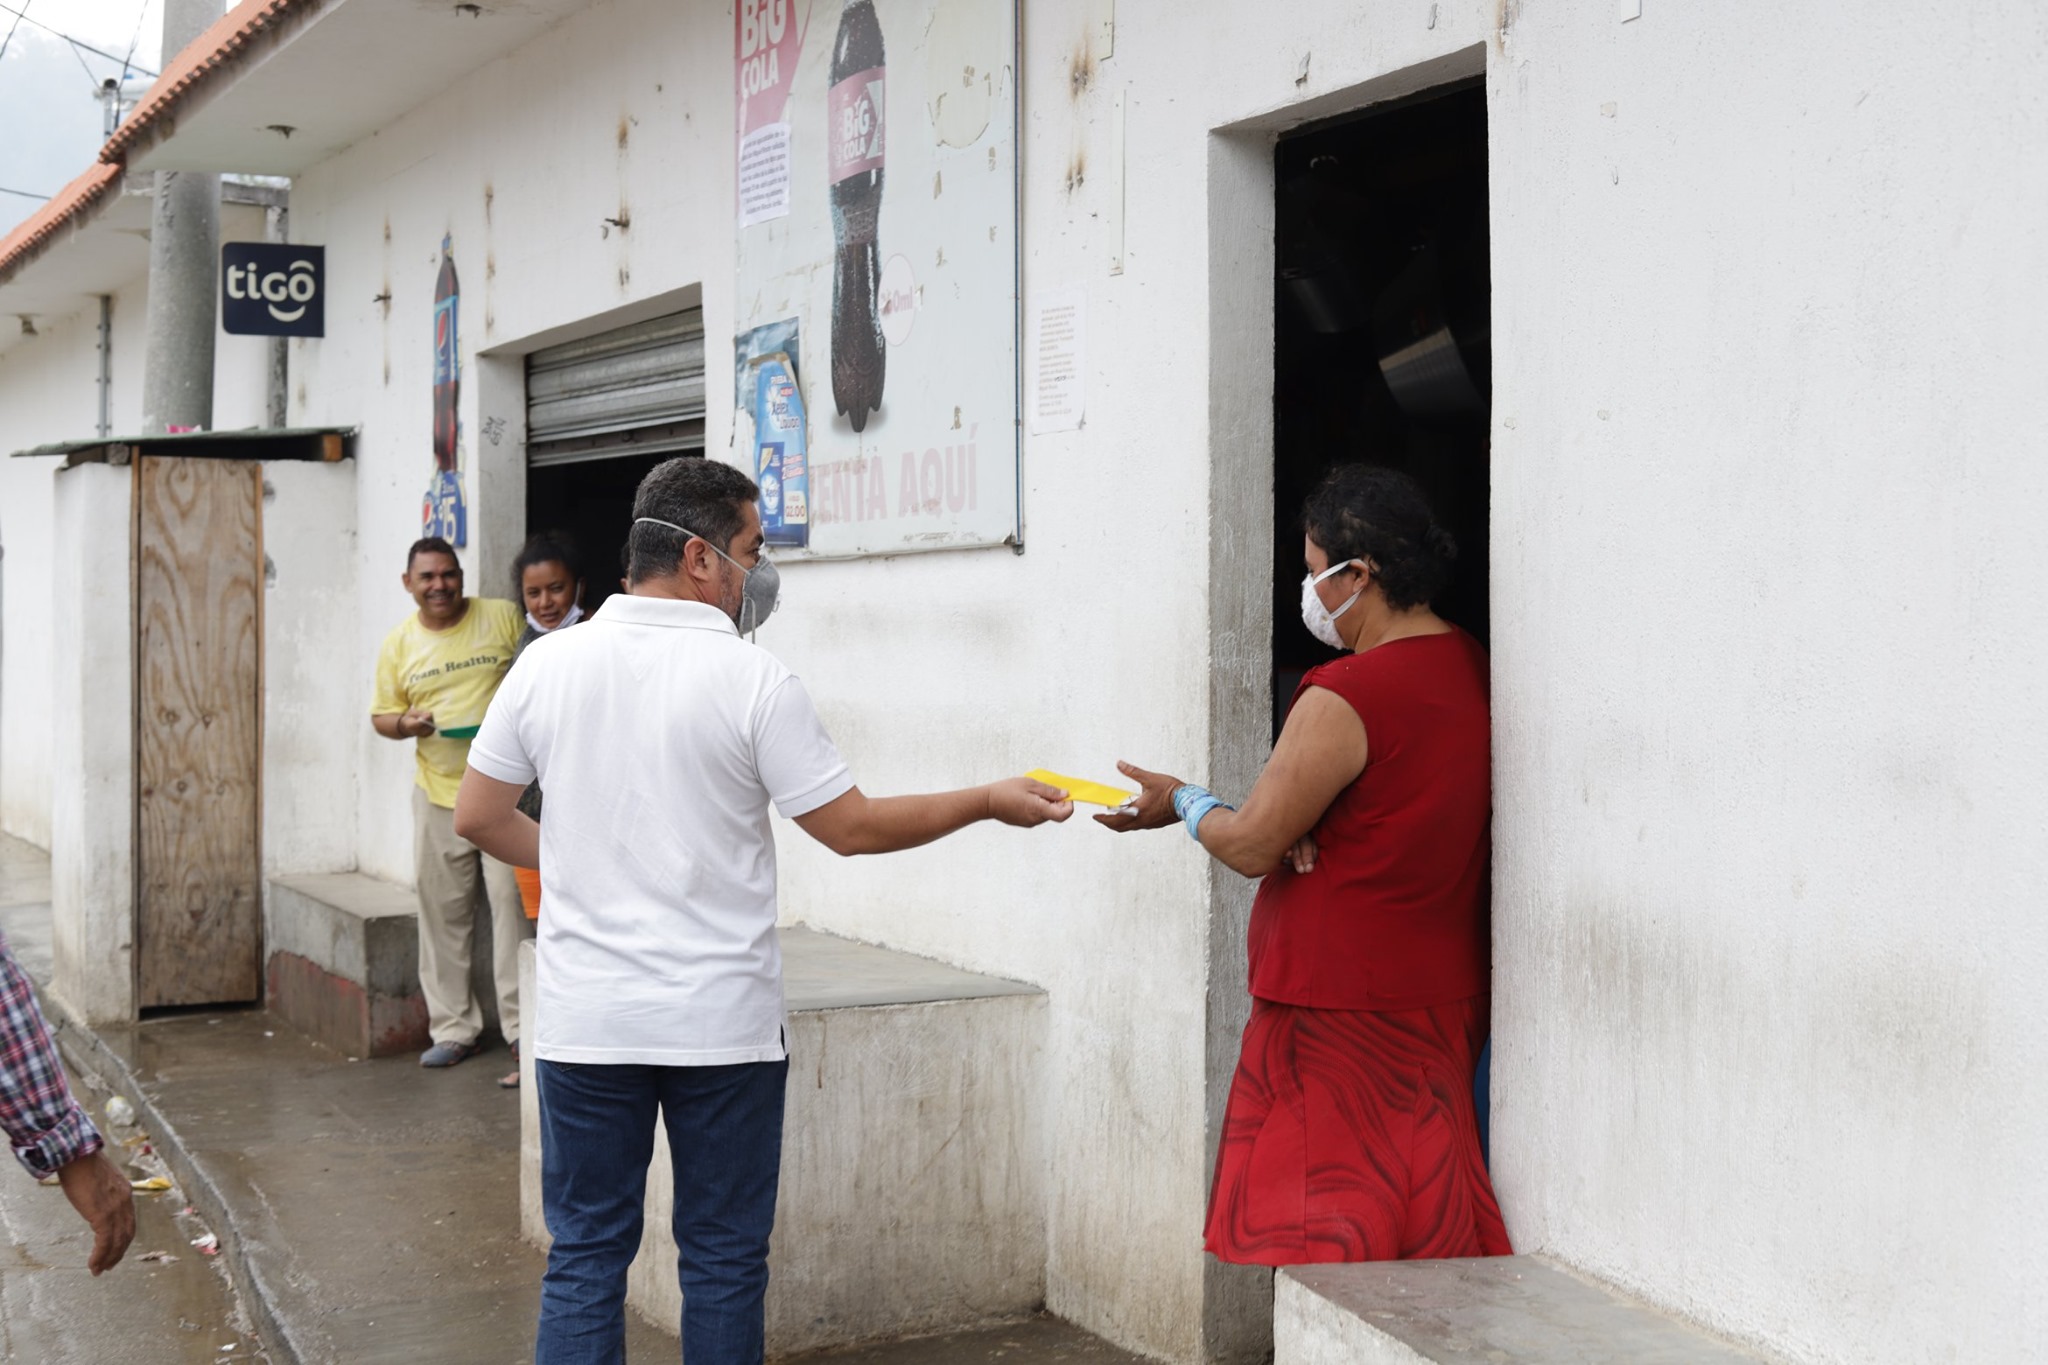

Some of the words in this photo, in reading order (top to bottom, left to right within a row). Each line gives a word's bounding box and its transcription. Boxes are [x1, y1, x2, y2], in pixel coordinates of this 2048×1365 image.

[741, 48, 779, 98] COLA
[844, 136, 866, 159] COLA
[898, 422, 979, 518] AQUÍ
[445, 655, 499, 673] Healthy
